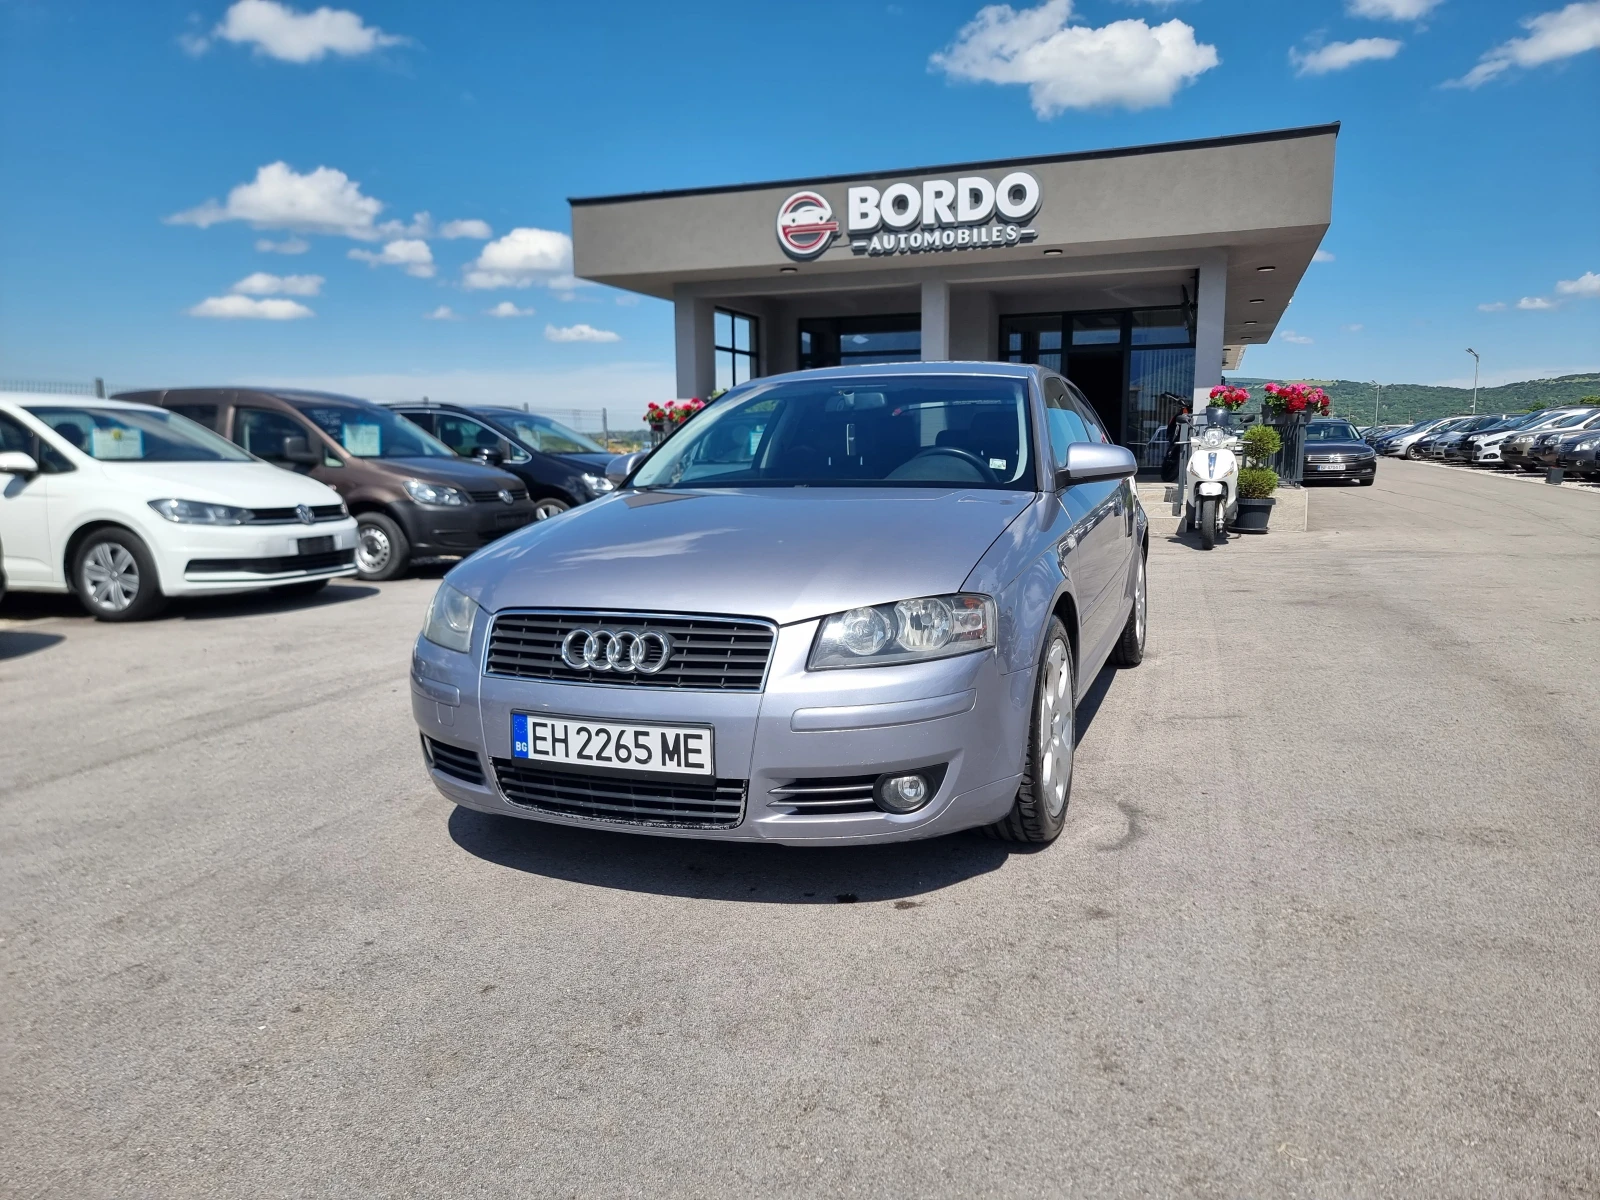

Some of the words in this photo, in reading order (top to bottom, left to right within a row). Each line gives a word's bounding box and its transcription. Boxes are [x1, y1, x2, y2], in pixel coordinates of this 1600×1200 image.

[849, 172, 1039, 230] BORDO
[870, 225, 1017, 250] AUTOMOBILES
[515, 741, 528, 752] BG
[532, 722, 570, 758] EH
[575, 726, 653, 765] 2265
[660, 731, 705, 769] ME
